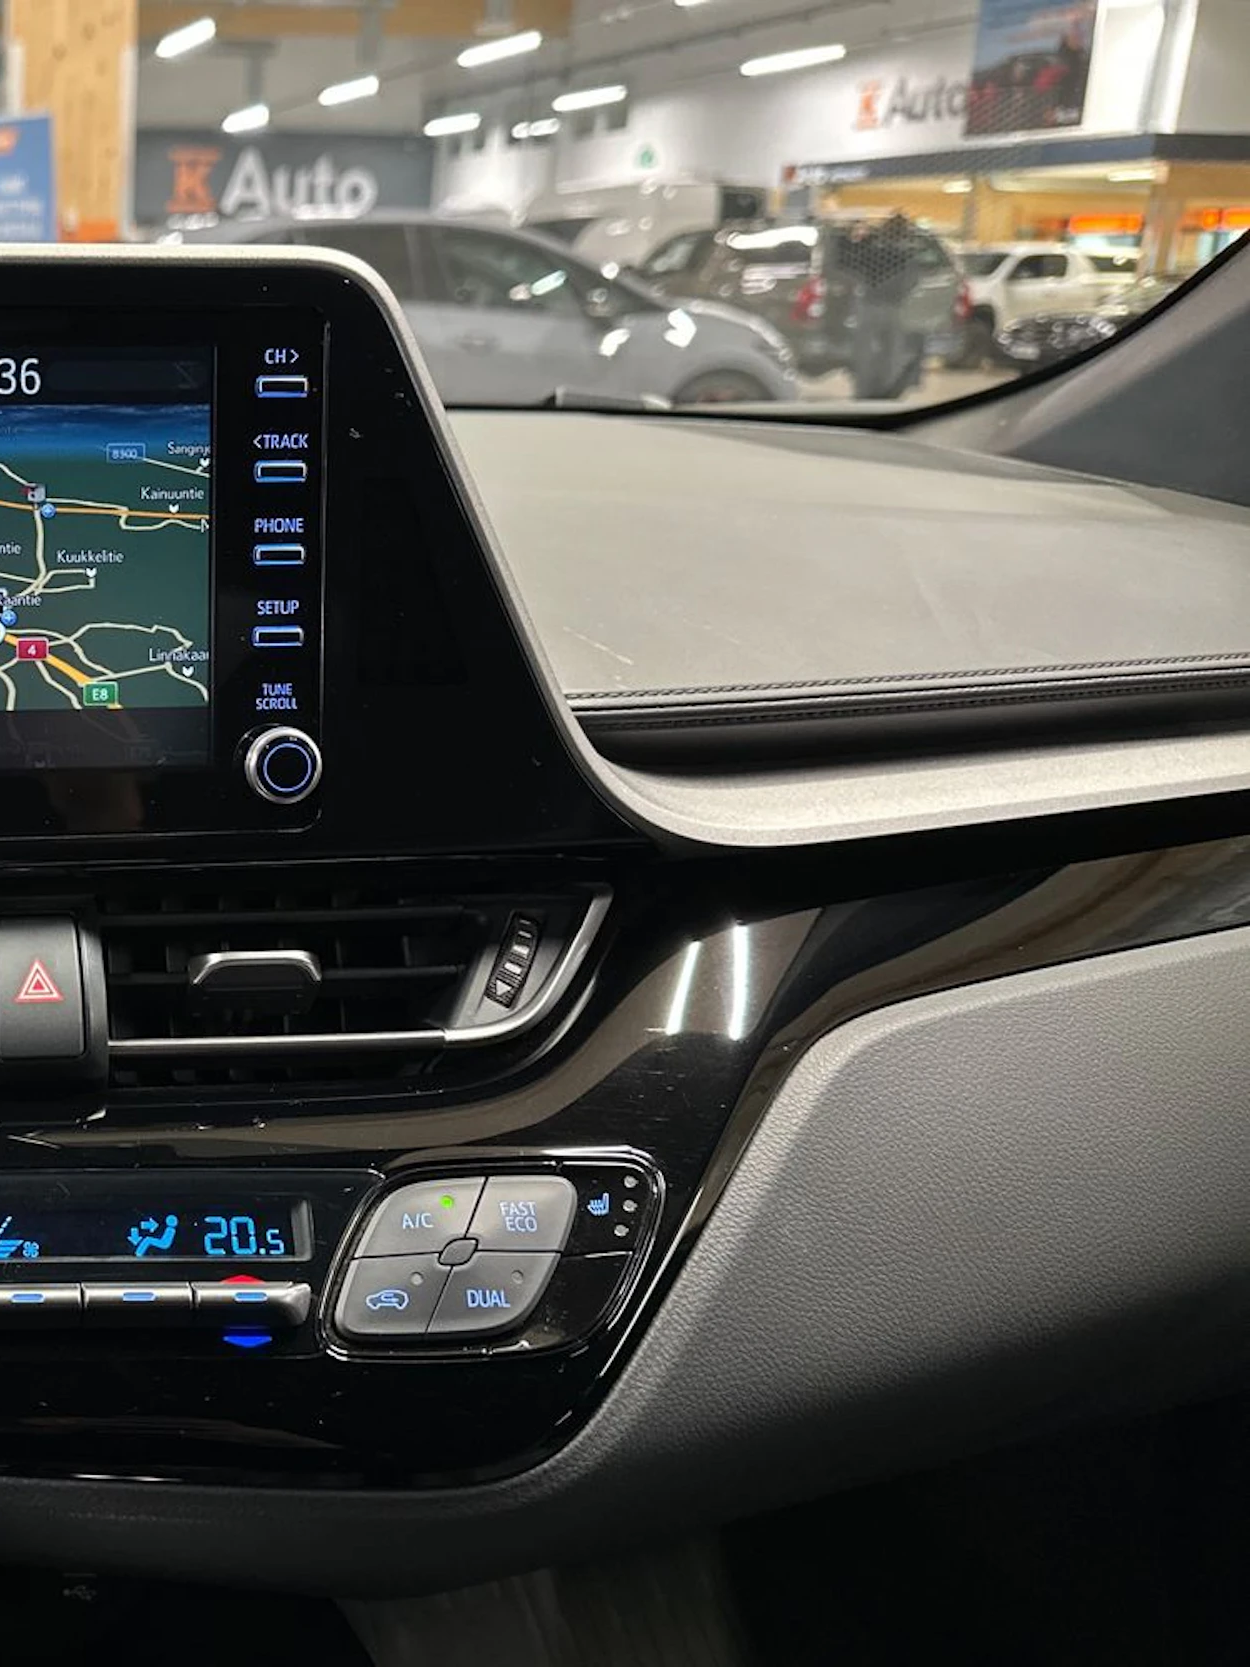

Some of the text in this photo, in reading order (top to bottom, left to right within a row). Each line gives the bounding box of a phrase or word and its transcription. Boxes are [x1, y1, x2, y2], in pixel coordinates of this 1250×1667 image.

[880, 76, 968, 127] Auto
[219, 146, 379, 217] Auto
[141, 486, 205, 500] Kainuuntie
[254, 518, 305, 532] PHONE
[57, 550, 125, 563] Kuukkelitie
[257, 600, 300, 615] SETUP
[92, 688, 109, 700] E8
[261, 683, 293, 696] TUNE
[255, 698, 298, 710] SCROLL
[499, 1201, 537, 1217] FAST
[402, 1212, 434, 1229] A/C
[504, 1217, 538, 1233] ECO
[203, 1215, 285, 1256] 20.5
[466, 1289, 511, 1308] DUAL
